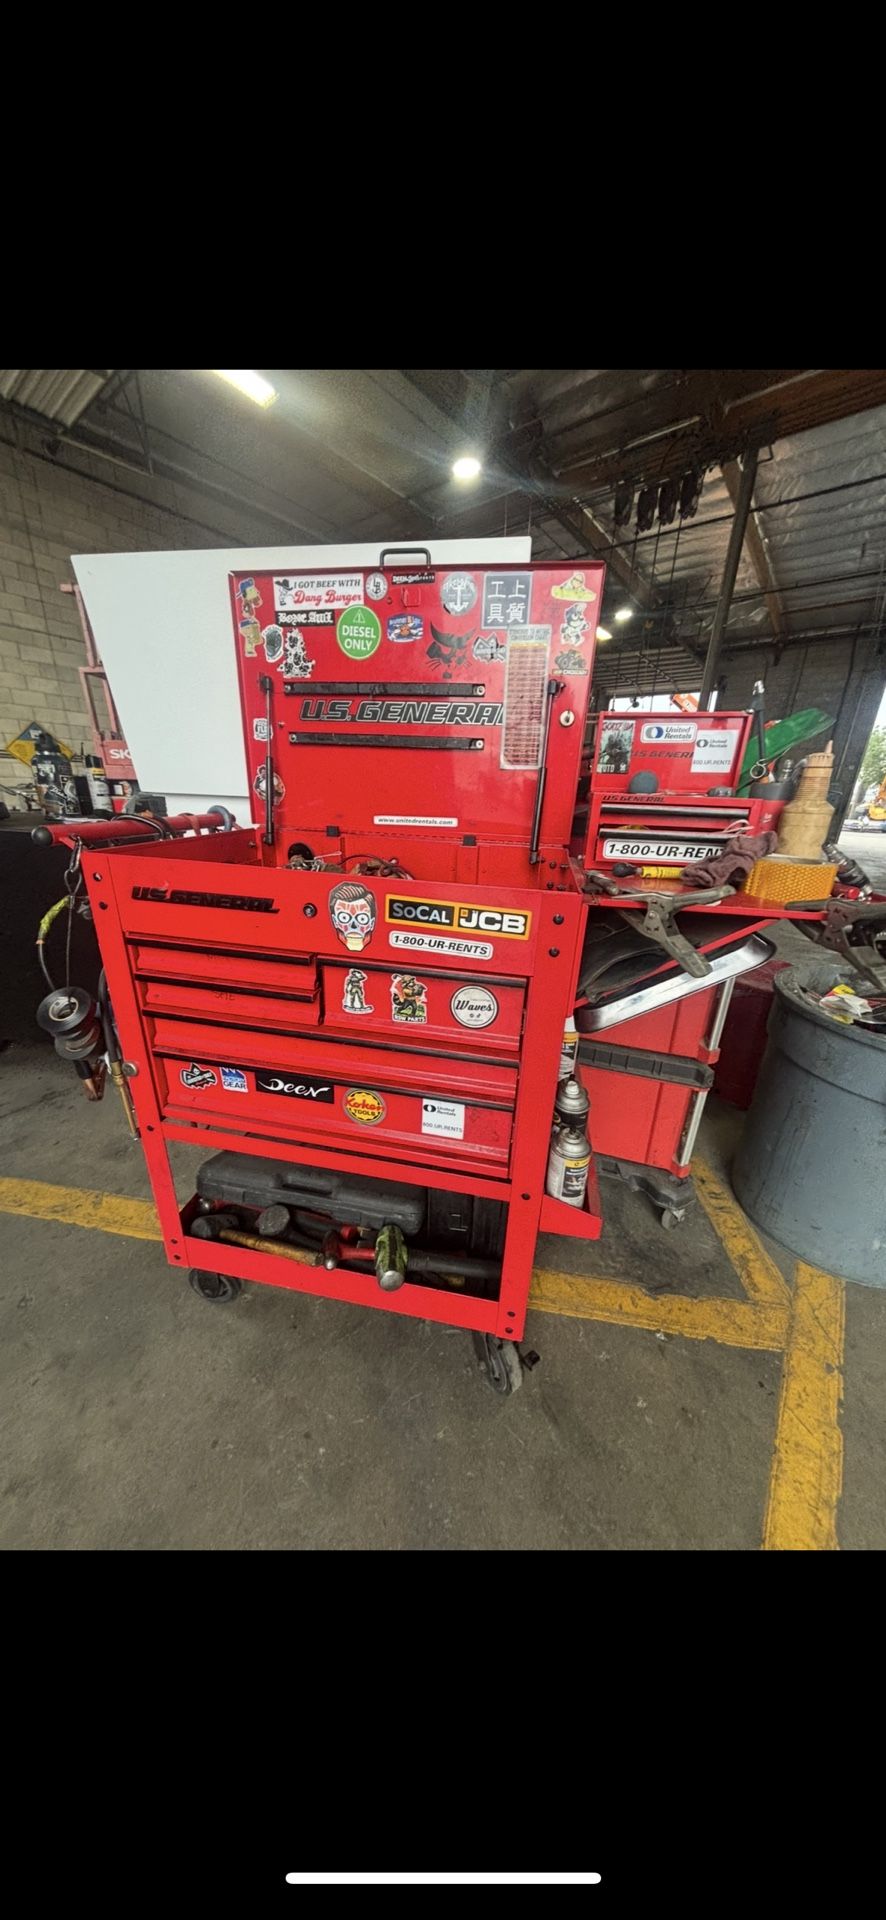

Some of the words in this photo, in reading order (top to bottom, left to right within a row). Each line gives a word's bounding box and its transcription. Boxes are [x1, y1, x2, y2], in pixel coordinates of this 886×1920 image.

[338, 579, 361, 587] WITH
[293, 589, 323, 606] Dang
[325, 587, 362, 605] Burger
[342, 625, 376, 639] DIESEL
[344, 637, 373, 651] ONLY
[302, 701, 351, 720] U.S.
[356, 702, 503, 725] GENERA
[665, 726, 691, 734] United
[378, 817, 453, 825] www.unitedrentals.com
[459, 911, 525, 933] JCB
[394, 936, 487, 954] 1-800-UR-RENTS
[455, 1000, 493, 1012] Waves
[223, 1080, 246, 1089] GEAR
[345, 1097, 385, 1112] Koken
[353, 1108, 376, 1116] TOOLS
